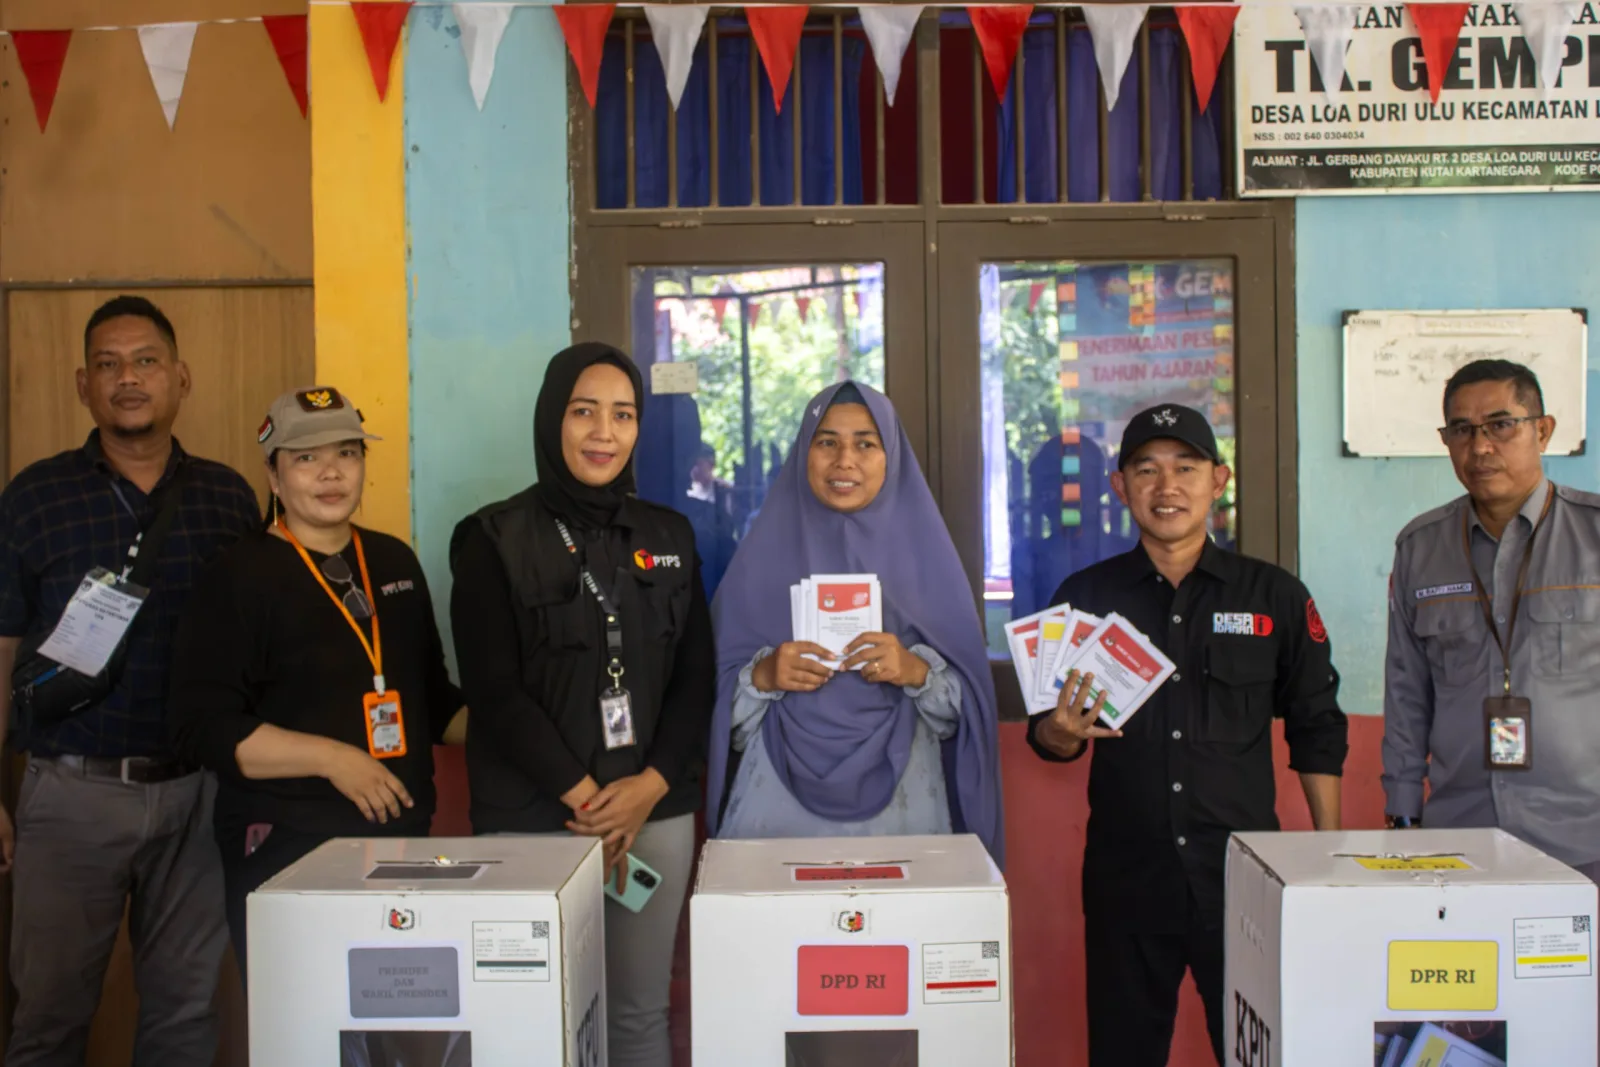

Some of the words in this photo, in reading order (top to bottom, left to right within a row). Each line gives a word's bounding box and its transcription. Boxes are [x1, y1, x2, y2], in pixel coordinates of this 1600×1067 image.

[1251, 104, 1305, 124] DESA
[1311, 103, 1351, 123] LOA
[1358, 102, 1407, 122] DURI
[1415, 101, 1455, 121] ULU
[1462, 99, 1588, 120] KECAMATAN
[1254, 132, 1276, 141] NSS
[1284, 132, 1301, 141] 002
[1252, 156, 1299, 167] ALAMAT
[1306, 155, 1324, 166] JL.
[1325, 154, 1384, 166] GERBANG
[1385, 153, 1430, 165] DAYAKU
[1433, 153, 1450, 164] RT.
[1451, 152, 1459, 163] 2
[1461, 151, 1491, 163] DESA
[1493, 151, 1518, 163] LOA
[1519, 151, 1547, 162] DURI
[1550, 151, 1572, 161] ULU
[1350, 168, 1418, 179] KABUPATEN
[1420, 166, 1455, 178] KUTAI
[1456, 165, 1542, 177] KARTANEGARA
[1554, 164, 1588, 176] KODE
[653, 555, 681, 568] PTPS
[820, 974, 859, 989] DPD
[865, 974, 886, 989] RI
[1410, 969, 1449, 984] DPR
[1455, 969, 1475, 984] RI
